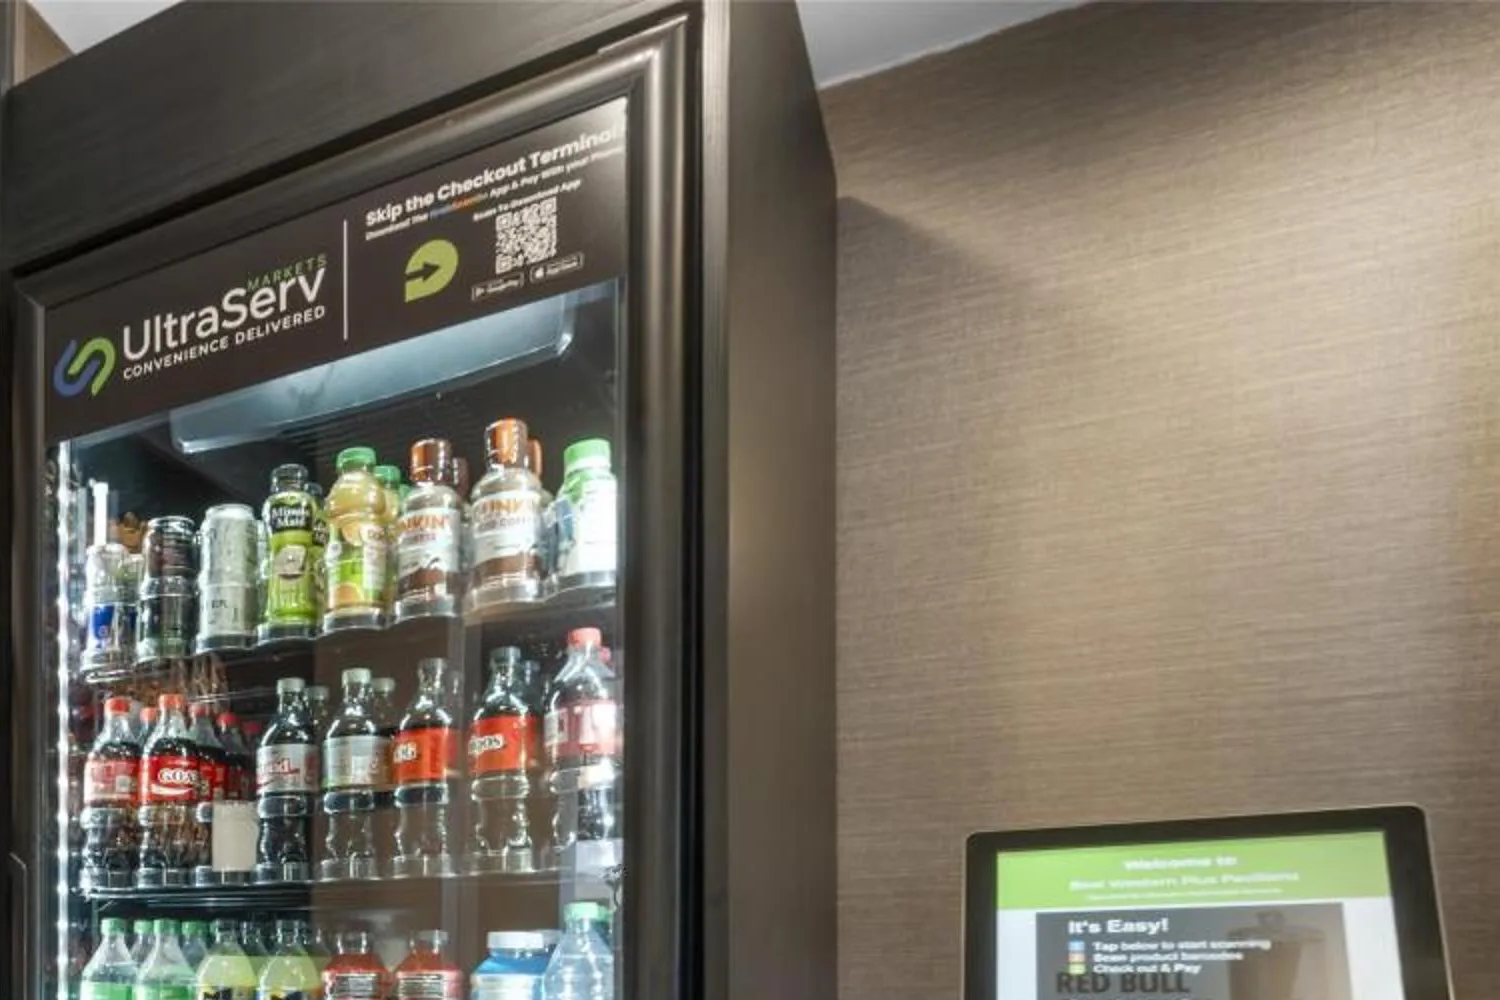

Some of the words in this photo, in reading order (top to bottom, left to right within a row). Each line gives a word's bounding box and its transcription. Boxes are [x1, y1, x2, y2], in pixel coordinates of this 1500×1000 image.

[366, 203, 403, 227] Skip
[405, 193, 435, 213] the
[437, 158, 527, 201] Checkout
[560, 178, 582, 193] App
[247, 252, 328, 290] MARKETS
[122, 267, 326, 361] UltraServ
[123, 335, 230, 381] CONVENIENCE
[234, 305, 326, 346] DELIVERED
[1067, 919, 1102, 934] It's
[1106, 917, 1169, 935] Easy!
[1092, 941, 1120, 953] Tap
[1120, 940, 1160, 951] below
[1092, 963, 1136, 974] Check
[1173, 963, 1203, 975] Pay
[1055, 972, 1112, 994] RED
[1119, 971, 1191, 994] BULL
